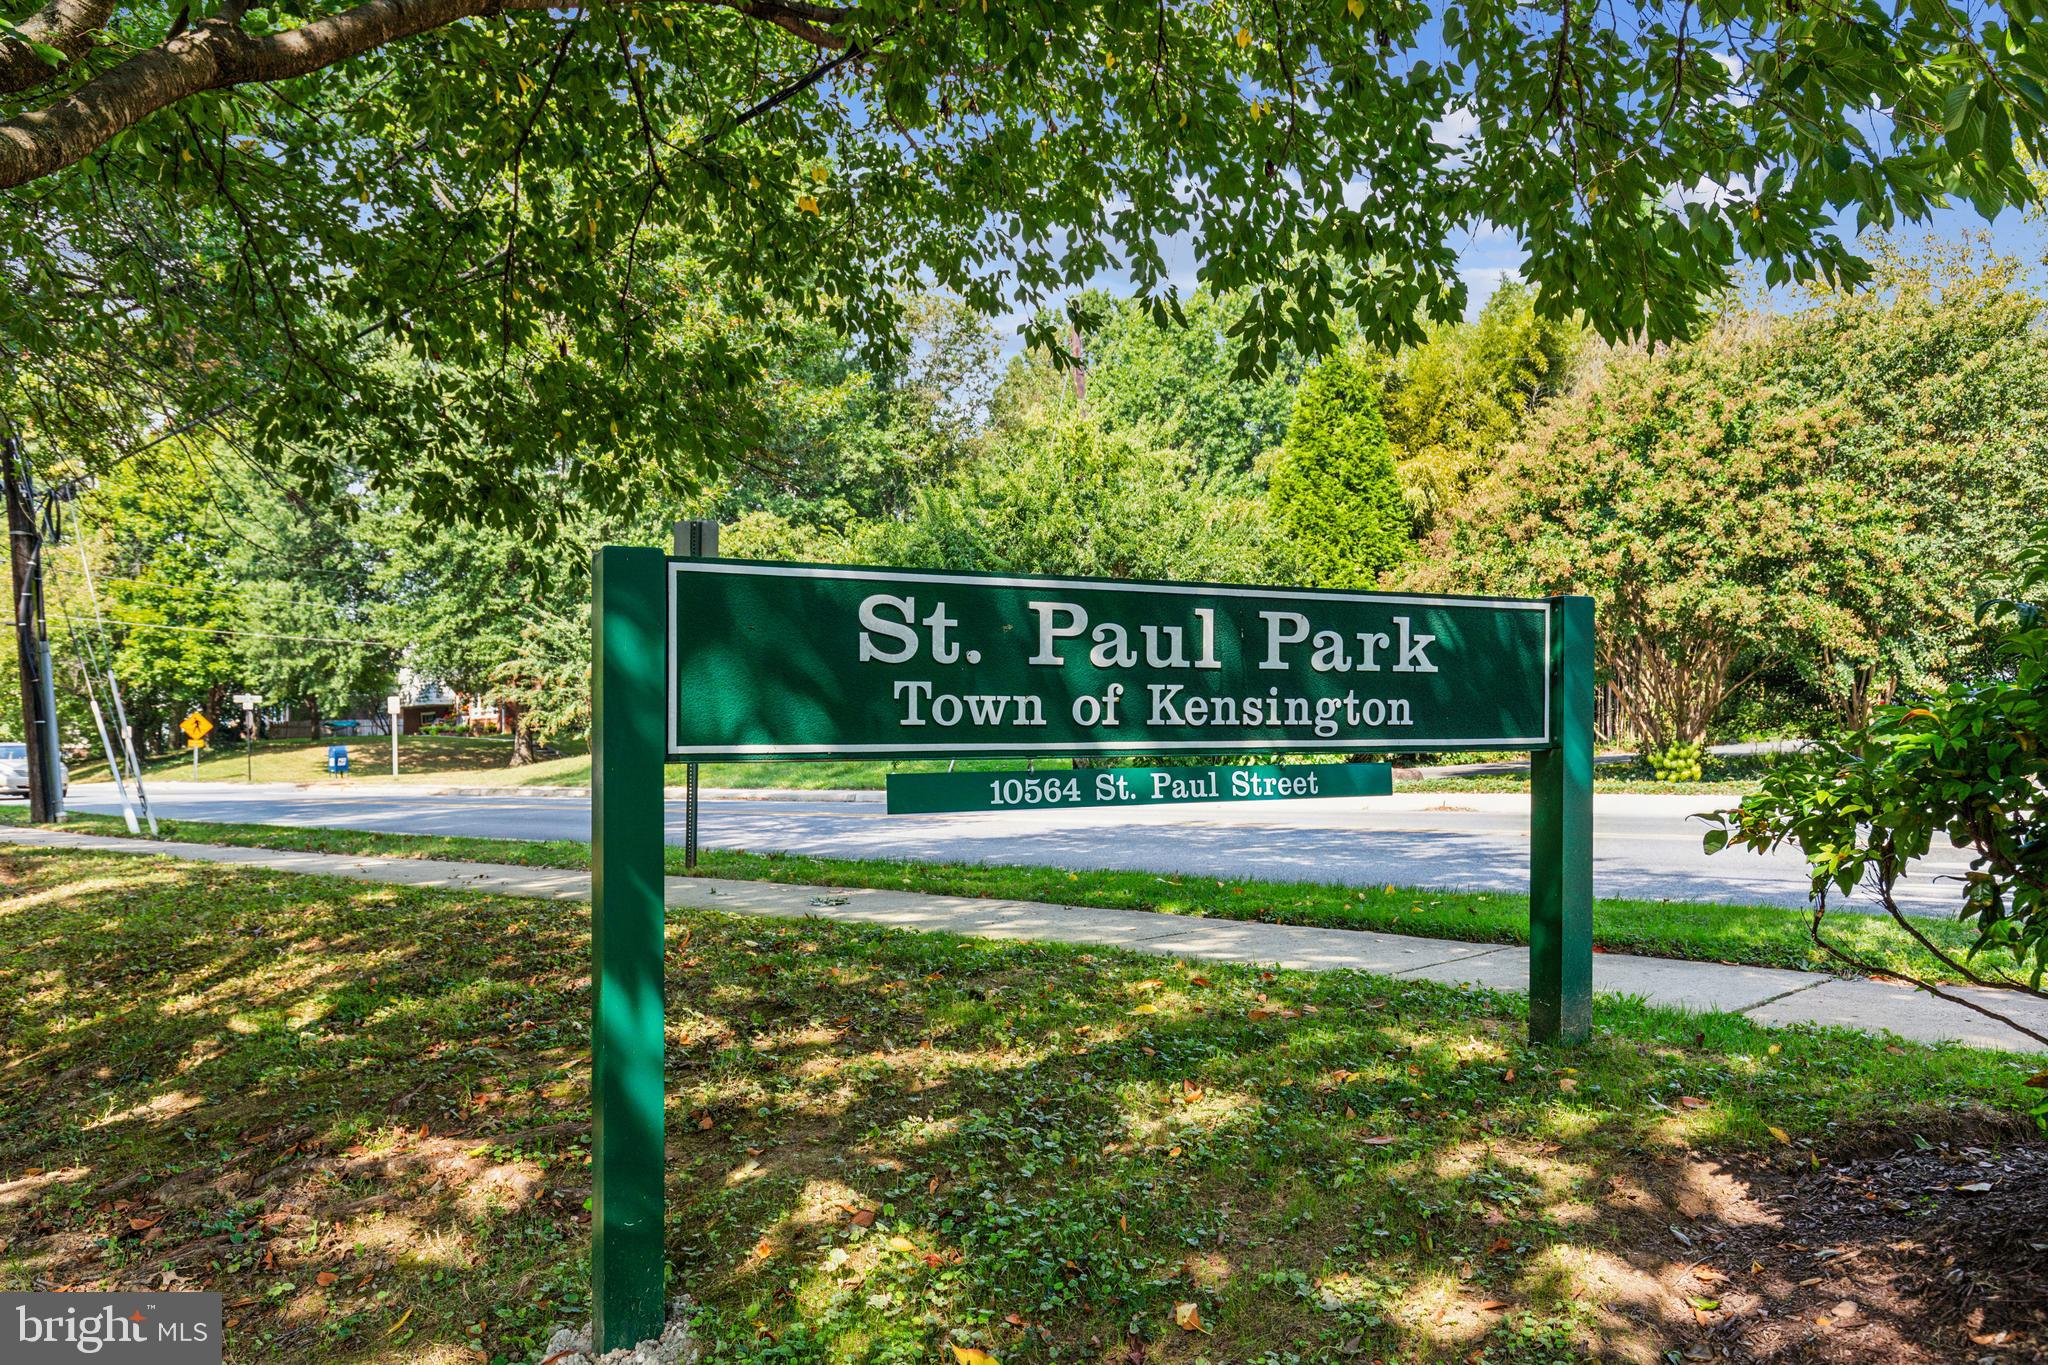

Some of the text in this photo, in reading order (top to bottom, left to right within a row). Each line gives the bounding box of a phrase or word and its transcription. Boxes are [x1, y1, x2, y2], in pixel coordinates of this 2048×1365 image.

[859, 594, 1439, 673] St. Paul Park
[893, 680, 1414, 738] Town of Kensington
[990, 768, 1319, 806] 10564 St. Paul Street
